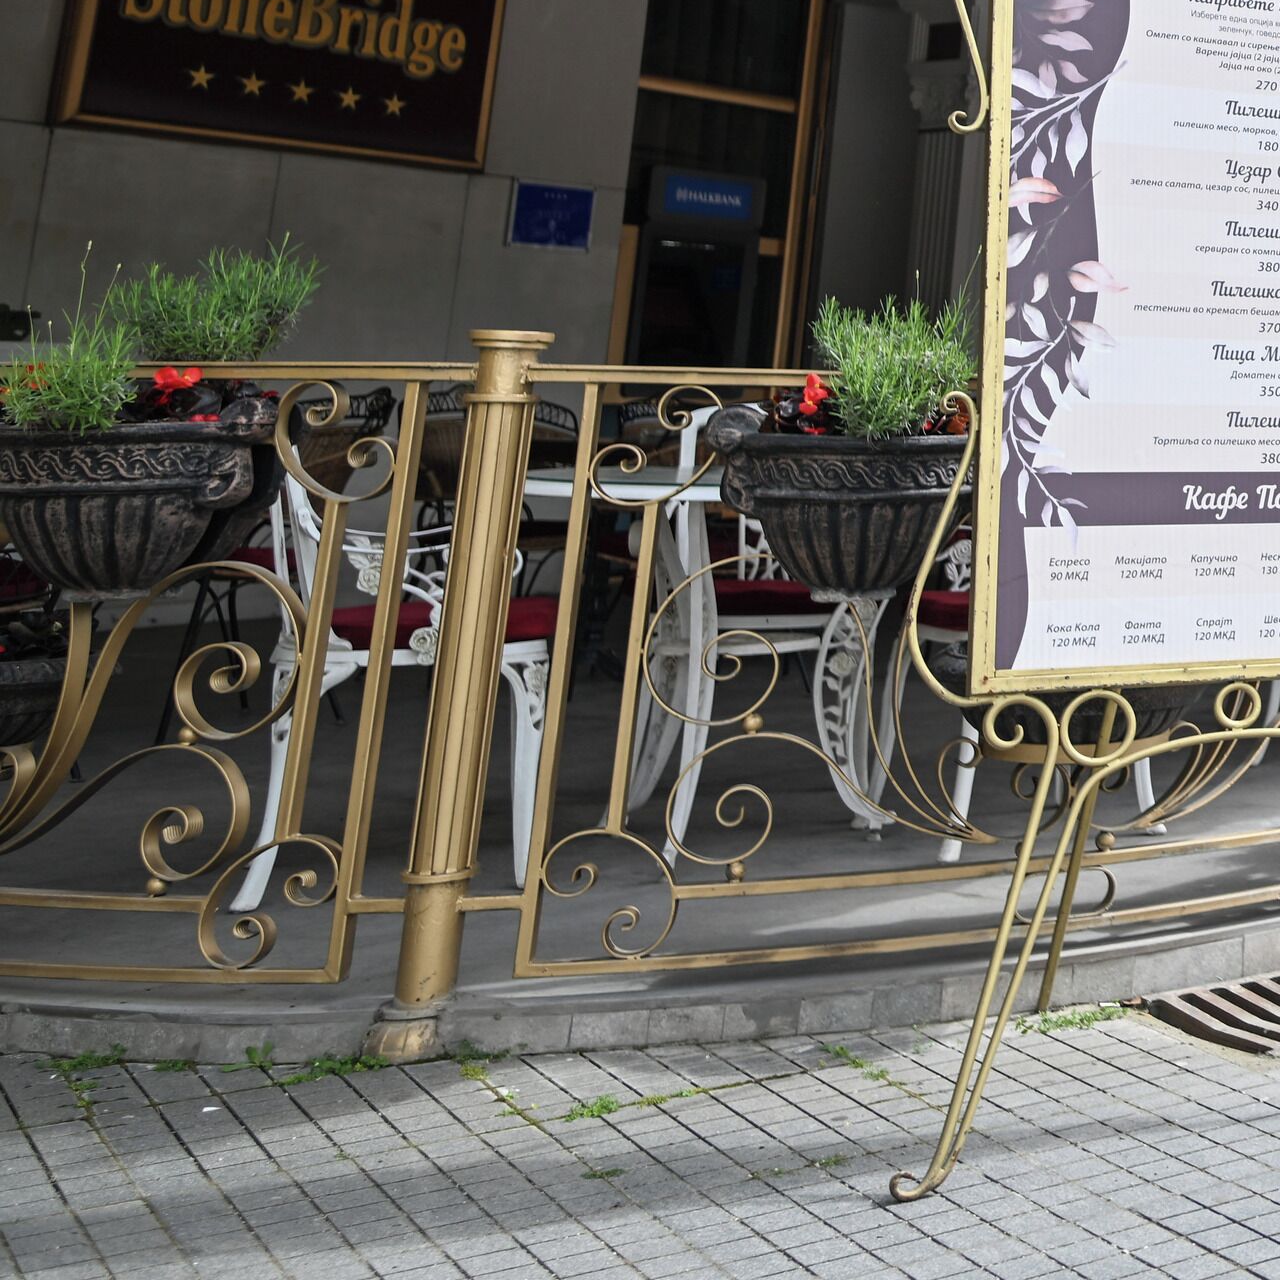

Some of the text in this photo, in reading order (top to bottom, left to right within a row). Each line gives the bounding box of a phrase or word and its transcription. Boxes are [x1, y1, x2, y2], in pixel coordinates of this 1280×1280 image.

[1145, 29, 1180, 40] Омлет
[1181, 34, 1192, 42] со
[1192, 36, 1239, 47] кашкавал
[1195, 46, 1229, 57] Варени
[1229, 50, 1252, 61] јајца
[1253, 52, 1262, 61] (2
[1218, 60, 1242, 71] Јајца
[1243, 64, 1255, 72] на
[1255, 79, 1278, 91] 270
[1173, 120, 1215, 130] пилешко
[1215, 124, 1241, 133] месо,
[1242, 126, 1278, 136] морков,
[1258, 140, 1279, 152] 180
[1225, 159, 1272, 183] Цезар
[1130, 178, 1163, 187] зелена
[1164, 180, 1203, 191] салата,
[1205, 184, 1233, 193] цезар
[1233, 185, 1251, 194] сос,
[688, 189, 743, 208] HALKBANK
[1256, 199, 1279, 211] 340
[1194, 245, 1239, 255] сервиран
[1240, 247, 1251, 255] со
[1257, 261, 1280, 273] 380
[1133, 304, 1191, 313] тестенини
[1192, 306, 1204, 314] во
[1205, 306, 1248, 316] кремаст
[1211, 344, 1255, 365] Пица
[1229, 370, 1276, 380] Доматен
[1200, 438, 1212, 446] со
[1213, 438, 1257, 446] пилешко
[1182, 484, 1249, 520] Кафе
[1048, 557, 1091, 568] Еспресо
[1114, 555, 1167, 566] Макијато
[1190, 554, 1238, 565] Капучино
[1050, 570, 1089, 582] 90 МКД
[1120, 568, 1163, 579] 120 МКД
[1194, 566, 1235, 577] 120 МКД
[1262, 565, 1278, 575] 130
[1046, 622, 1100, 633] Кока Кола
[1124, 620, 1162, 630] Фанта
[1195, 617, 1233, 629] Спрајт
[1122, 633, 1165, 644] 120 МКД
[1195, 630, 1236, 641] 120 МКД
[1259, 628, 1275, 638] 120
[1052, 636, 1096, 647] 120 МКД
